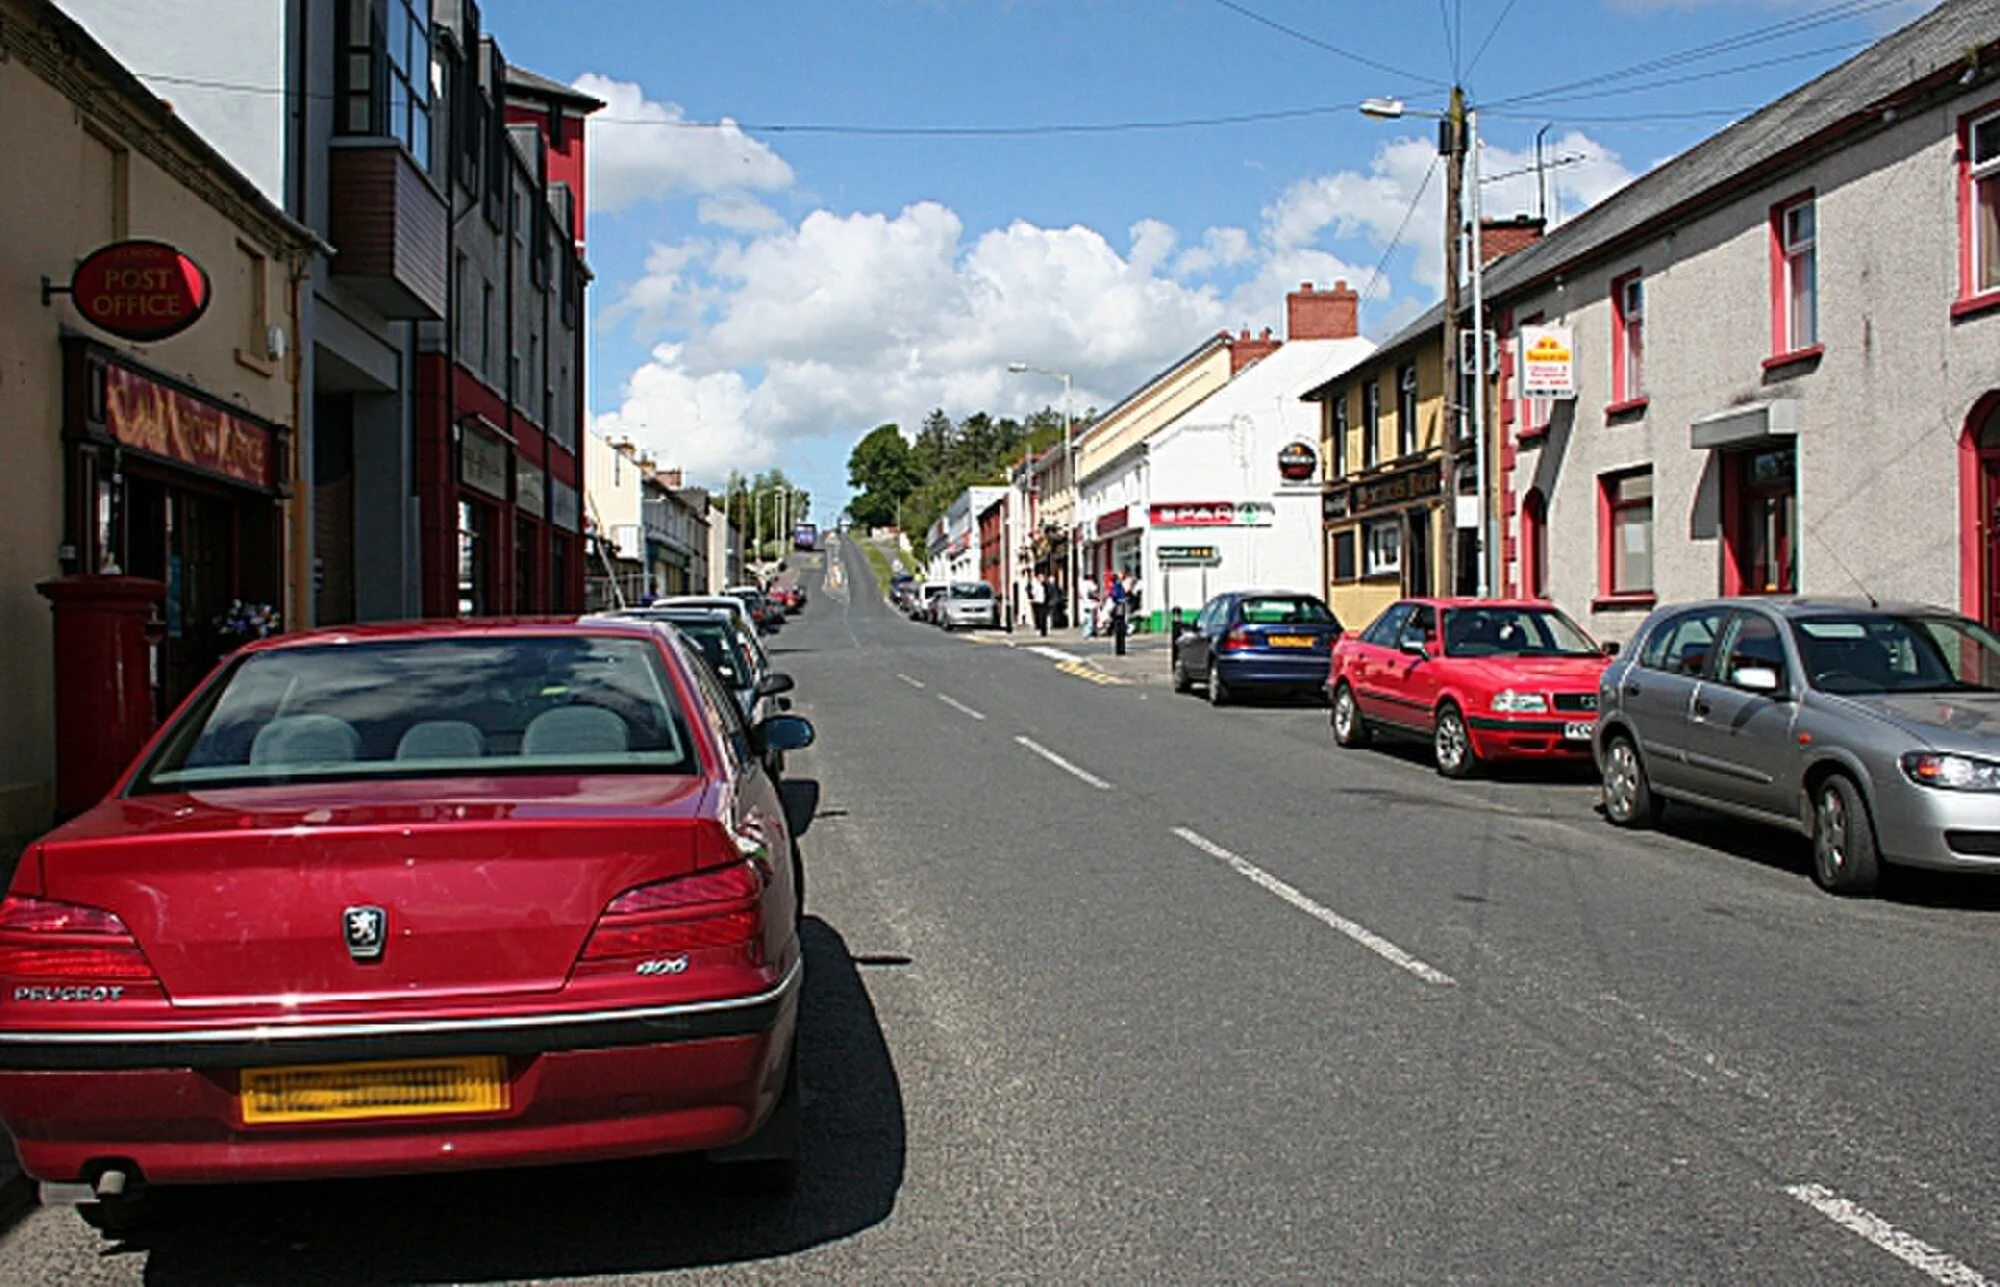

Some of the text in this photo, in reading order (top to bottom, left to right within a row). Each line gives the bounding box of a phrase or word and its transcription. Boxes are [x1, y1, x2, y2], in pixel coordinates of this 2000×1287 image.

[104, 267, 173, 291] POST
[92, 293, 181, 317] OFFICE
[634, 953, 689, 976] 406
[13, 985, 125, 1001] PEUGEOT
